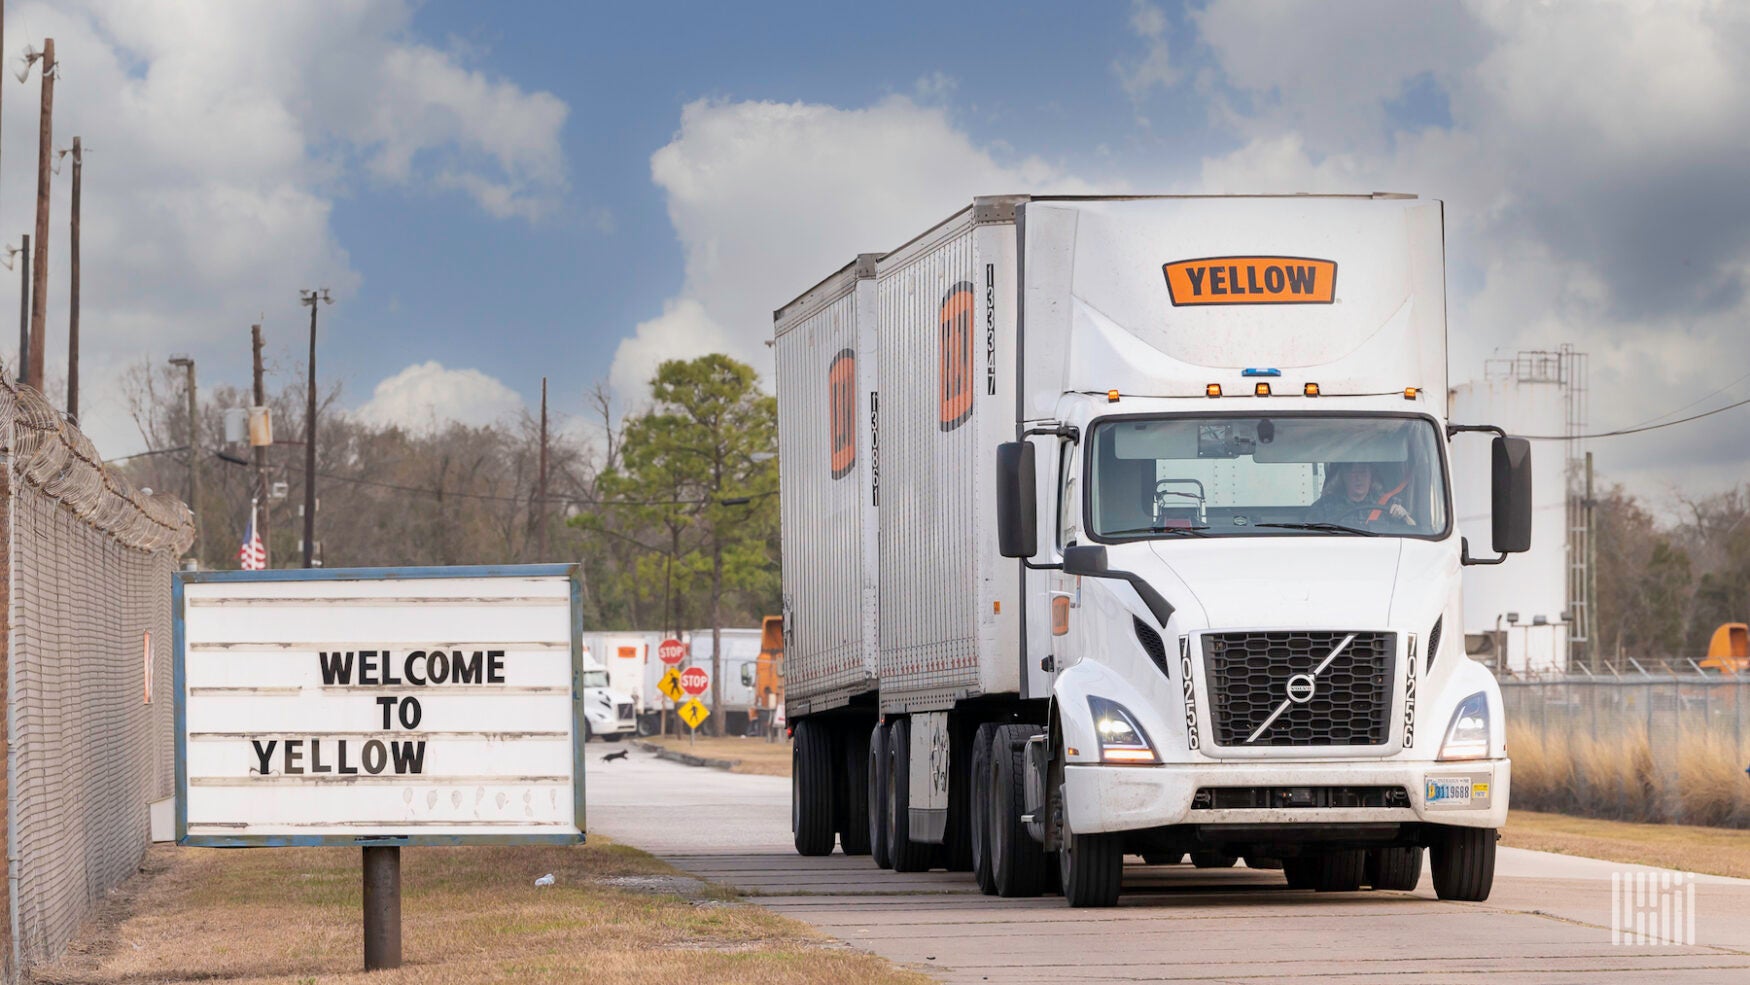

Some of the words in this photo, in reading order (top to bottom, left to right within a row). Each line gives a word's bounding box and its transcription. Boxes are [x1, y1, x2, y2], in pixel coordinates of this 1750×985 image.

[1185, 265, 1316, 296] YELLOW
[987, 264, 996, 395] 133347
[871, 392, 880, 506] 130861
[319, 650, 506, 686] WELCOME
[660, 646, 684, 658] STOP
[681, 675, 707, 688] STOP
[1179, 634, 1200, 750] 70256
[1403, 633, 1417, 749] 70256
[376, 696, 422, 730] TO
[252, 739, 427, 775] YELLOW
